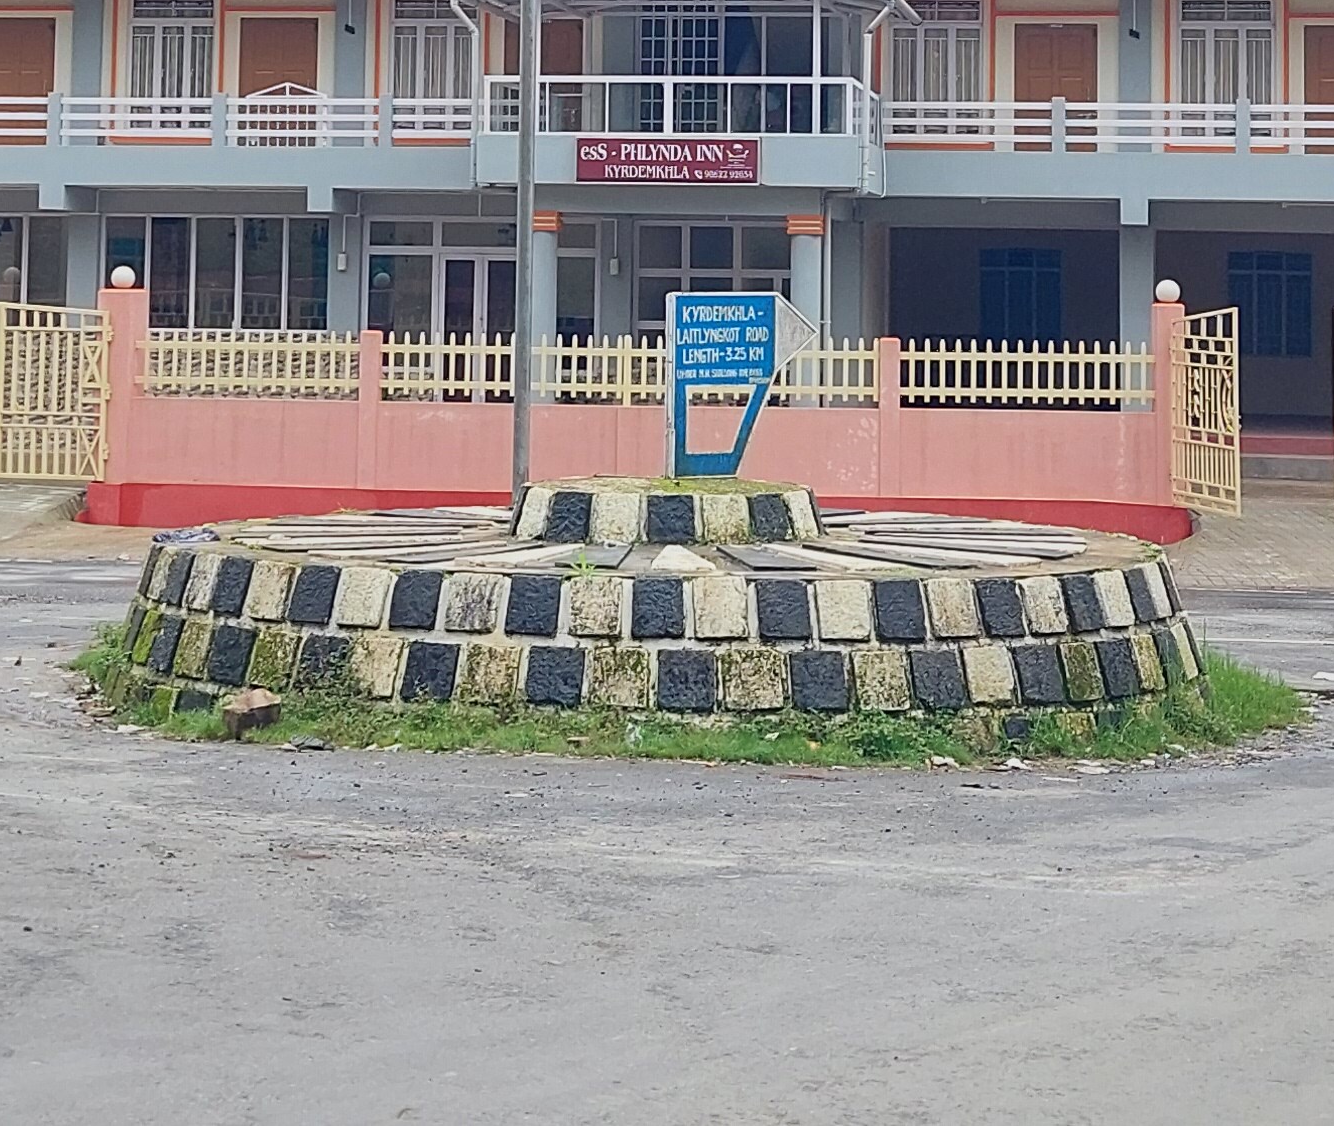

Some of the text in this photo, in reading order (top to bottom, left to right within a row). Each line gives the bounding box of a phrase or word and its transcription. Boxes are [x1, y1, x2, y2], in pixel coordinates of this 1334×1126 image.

[580, 143, 608, 161] esS
[620, 143, 692, 162] PHLYNDA
[696, 144, 725, 162] INN
[604, 165, 690, 180] KYRDEMKHLA
[677, 326, 769, 345] LAITLYNGKOT ROAD
[749, 346, 765, 362] KM
